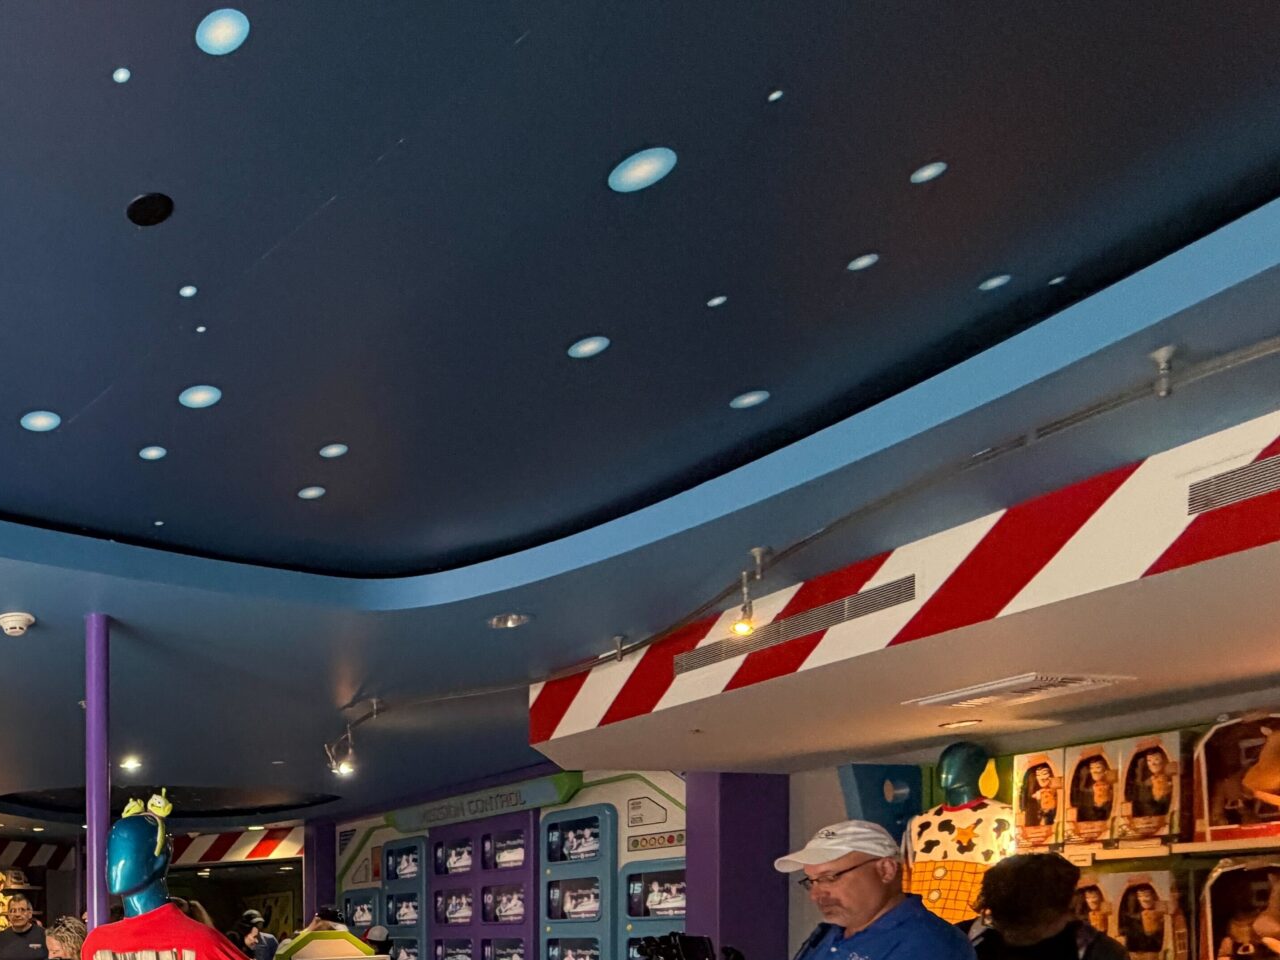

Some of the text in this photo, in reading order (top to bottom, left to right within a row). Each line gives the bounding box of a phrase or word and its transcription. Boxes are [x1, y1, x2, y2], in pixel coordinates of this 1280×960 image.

[467, 790, 527, 815] CONTROL
[549, 831, 559, 842] 12
[630, 883, 642, 893] 15
[484, 893, 493, 905] 10
[550, 889, 560, 900] 13
[549, 946, 559, 957] 14
